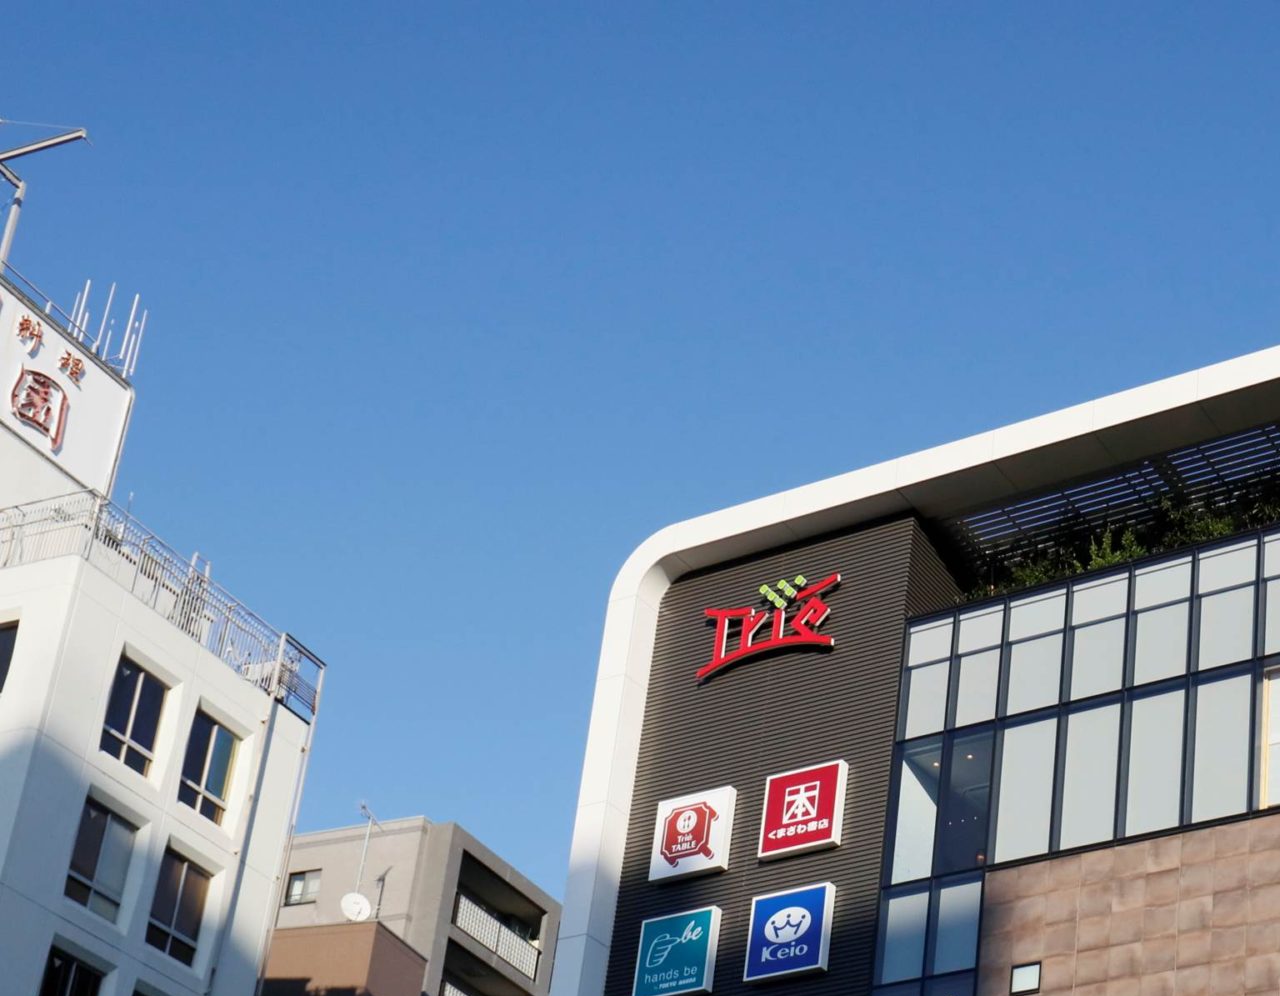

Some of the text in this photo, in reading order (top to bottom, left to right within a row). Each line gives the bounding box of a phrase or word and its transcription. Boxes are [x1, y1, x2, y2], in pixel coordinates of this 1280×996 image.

[768, 818, 829, 839] くまざわ書店
[672, 840, 697, 852] TABLE
[761, 941, 808, 962] Keio
[645, 966, 697, 984] hands be
